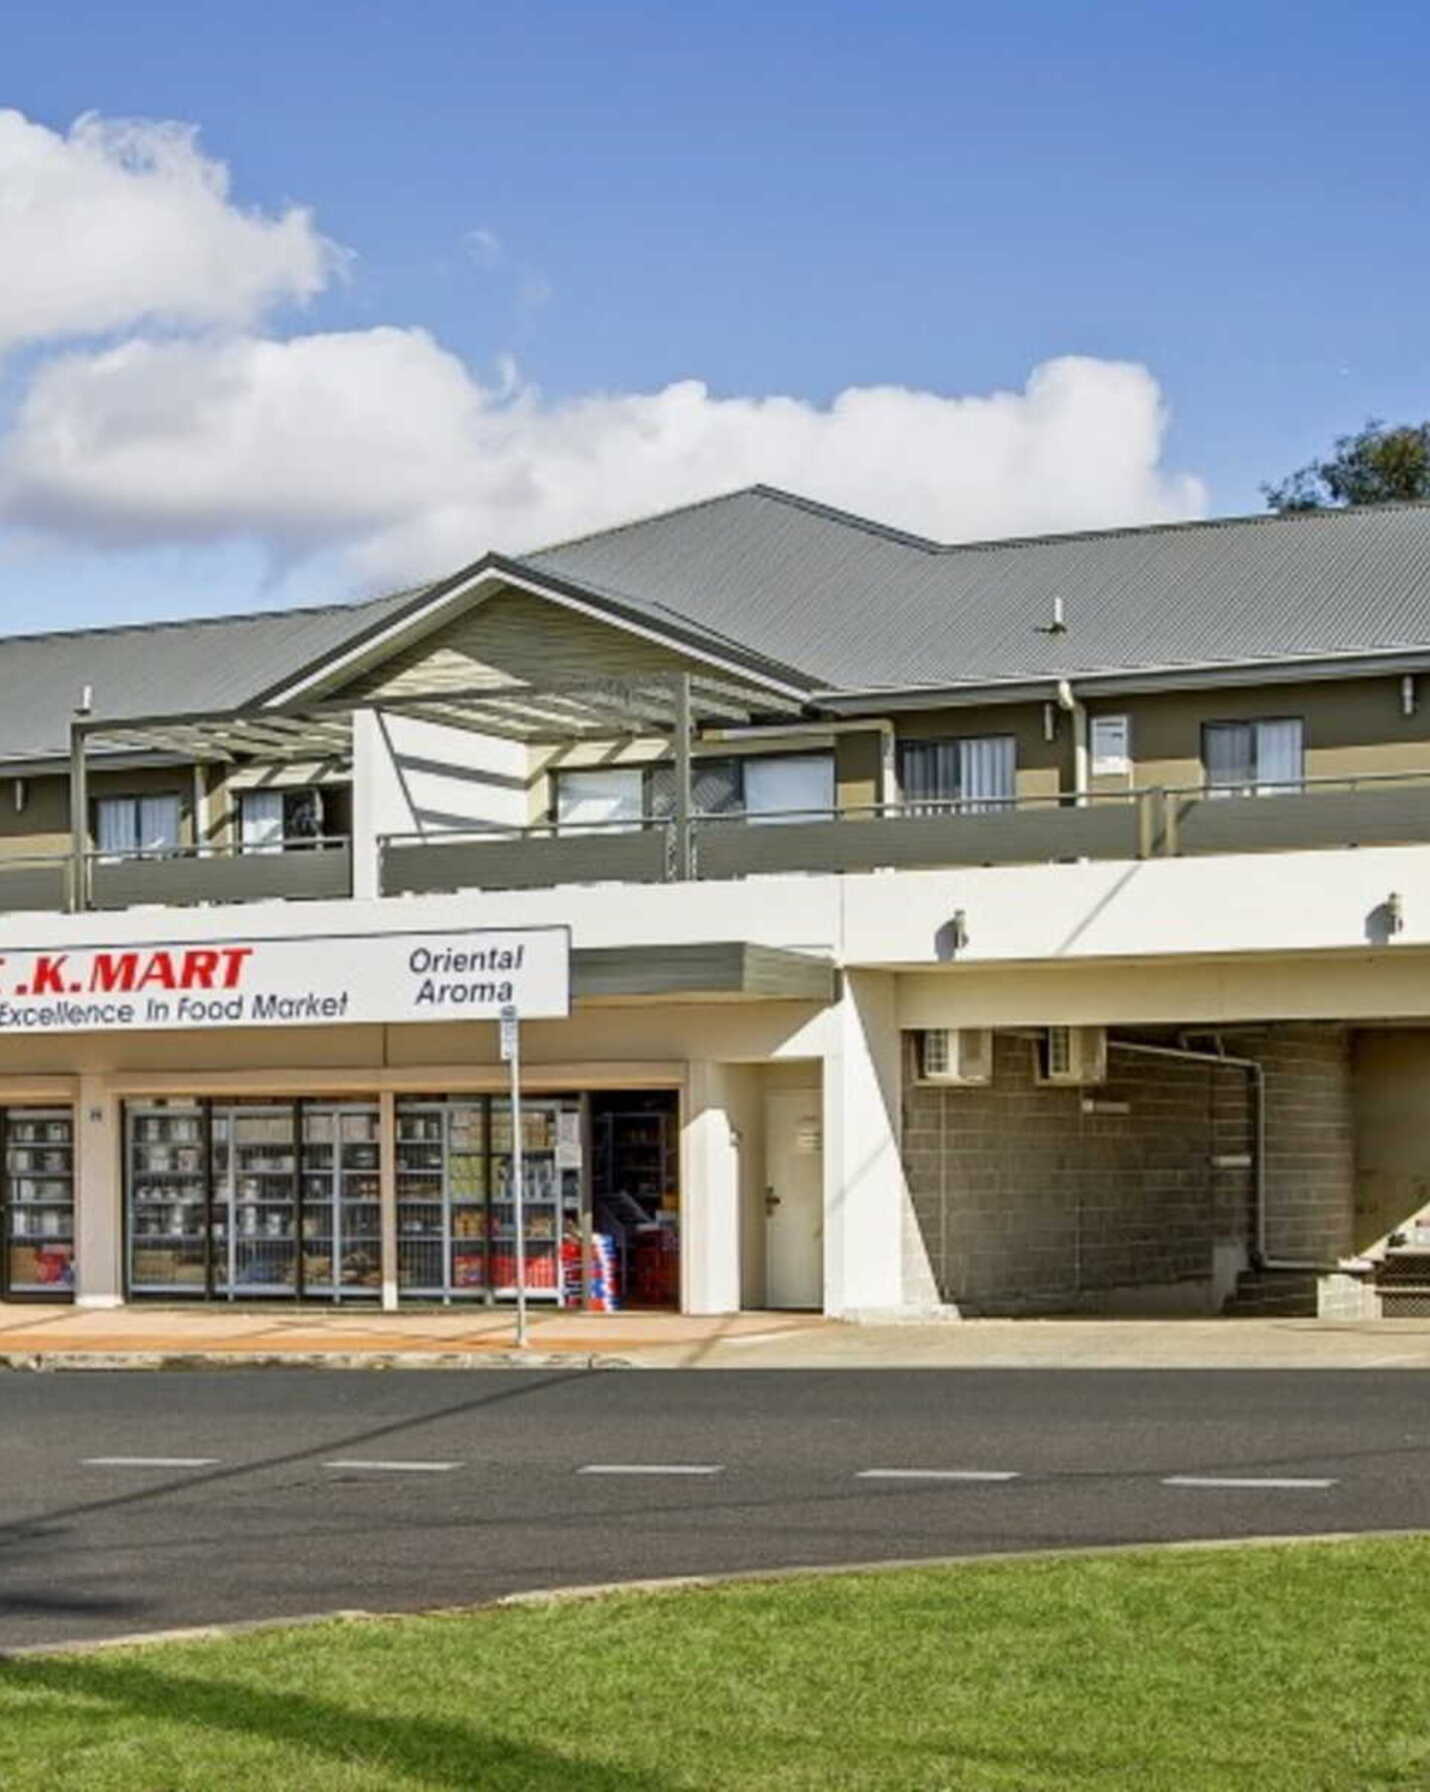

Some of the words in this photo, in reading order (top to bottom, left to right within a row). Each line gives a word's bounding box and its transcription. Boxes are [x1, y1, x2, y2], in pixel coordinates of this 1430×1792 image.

[0, 947, 254, 996] .K.MART
[409, 943, 525, 974] Oriental
[414, 977, 513, 1005] Aroma
[0, 1000, 134, 1027] Excellence
[146, 998, 170, 1021] In
[177, 995, 244, 1021] Food
[251, 991, 349, 1020] Market
